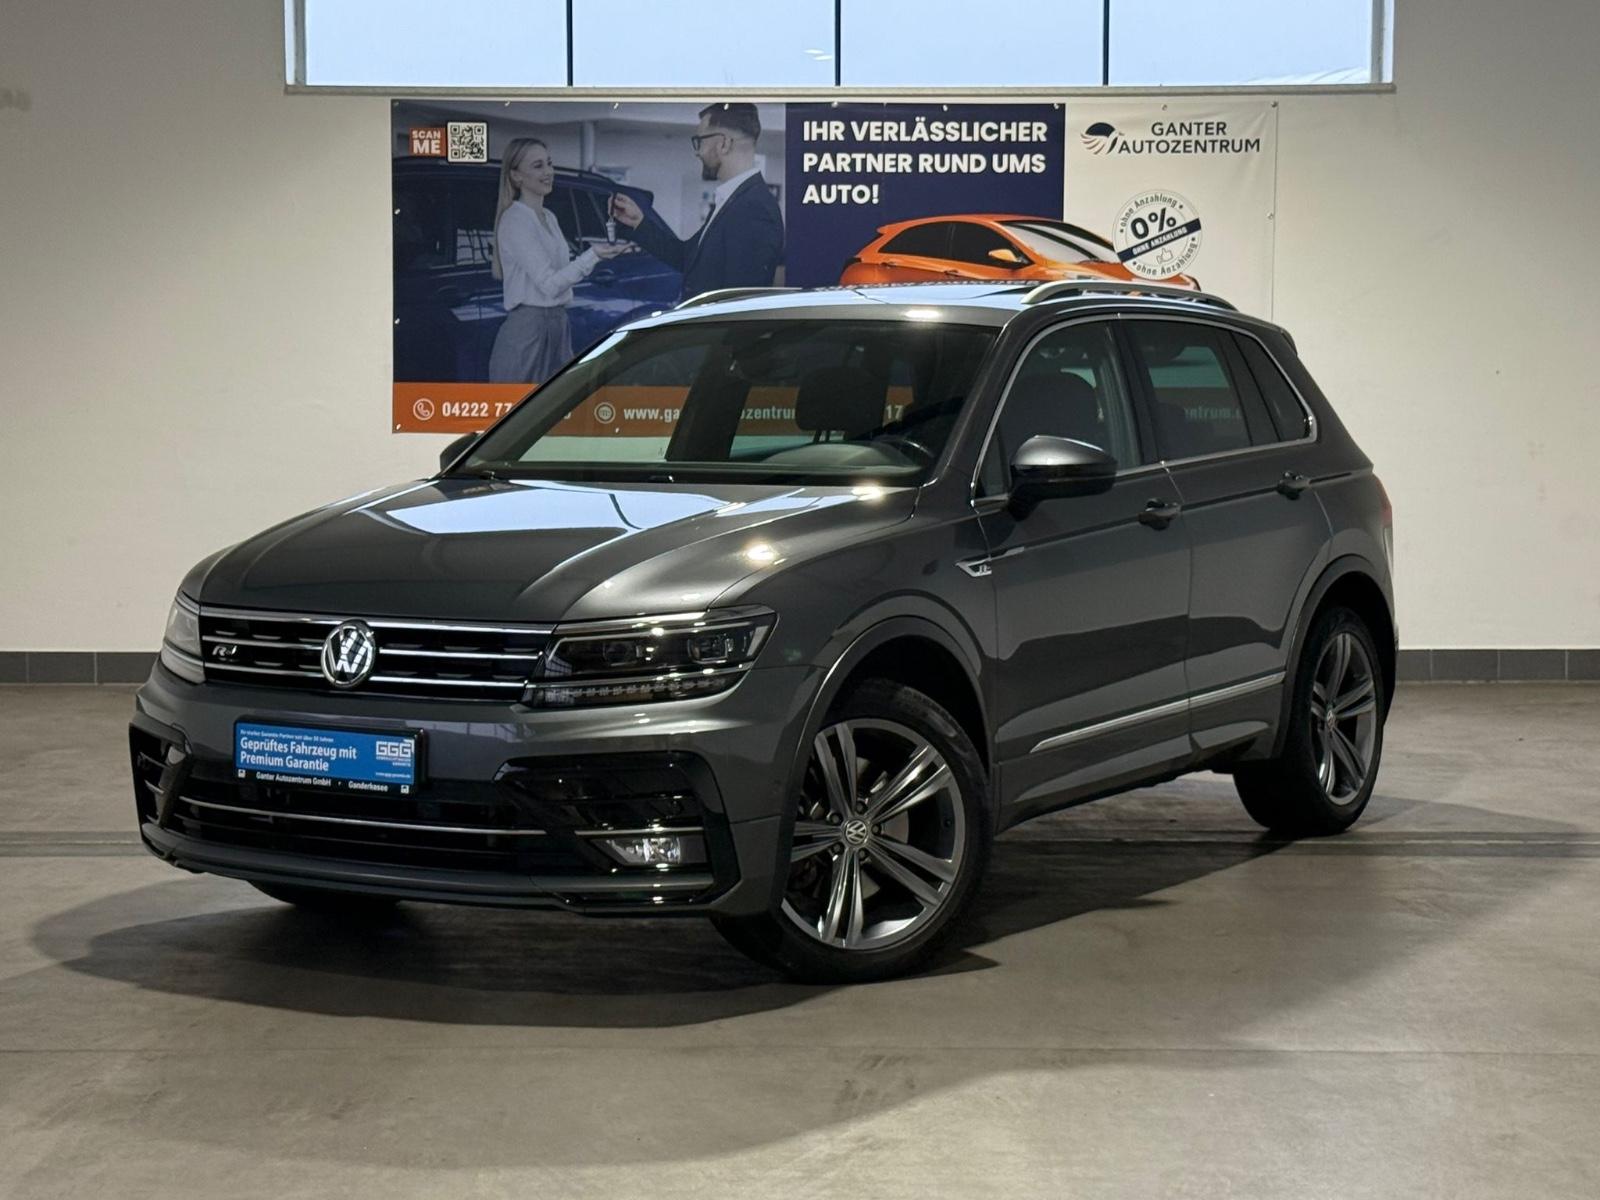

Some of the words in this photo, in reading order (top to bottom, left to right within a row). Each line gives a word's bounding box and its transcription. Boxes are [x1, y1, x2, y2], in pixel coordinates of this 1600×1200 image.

[412, 130, 441, 139] SCAN
[803, 121, 845, 141] IHR
[850, 116, 1047, 142] VERLÄSSLICHER
[1151, 121, 1227, 136] GANTER
[413, 140, 441, 154] ME
[1118, 138, 1260, 154] AUTOZENTRUM
[803, 153, 912, 173] PARTNER
[918, 154, 986, 173] RUND
[992, 154, 1046, 174] UMS
[802, 184, 879, 204] AUTO!
[1121, 207, 1134, 227] ohne
[1134, 193, 1178, 209] Anzahlung
[1131, 207, 1177, 239] 0%
[1132, 241, 1151, 255] OHNE
[1150, 226, 1188, 248] ANZAHLUNG
[1136, 264, 1157, 275] ohne
[1160, 242, 1198, 275] Anzahlung
[442, 402, 489, 417] 04222
[240, 737, 289, 754] Geprüftes
[290, 741, 337, 760] Fahrzeug
[338, 746, 357, 760] mit
[240, 751, 284, 766] Premium
[285, 755, 329, 771] Garantie
[256, 771, 275, 780] Ganter
[275, 773, 312, 785] Autozentrum
[313, 777, 331, 787] GmbH
